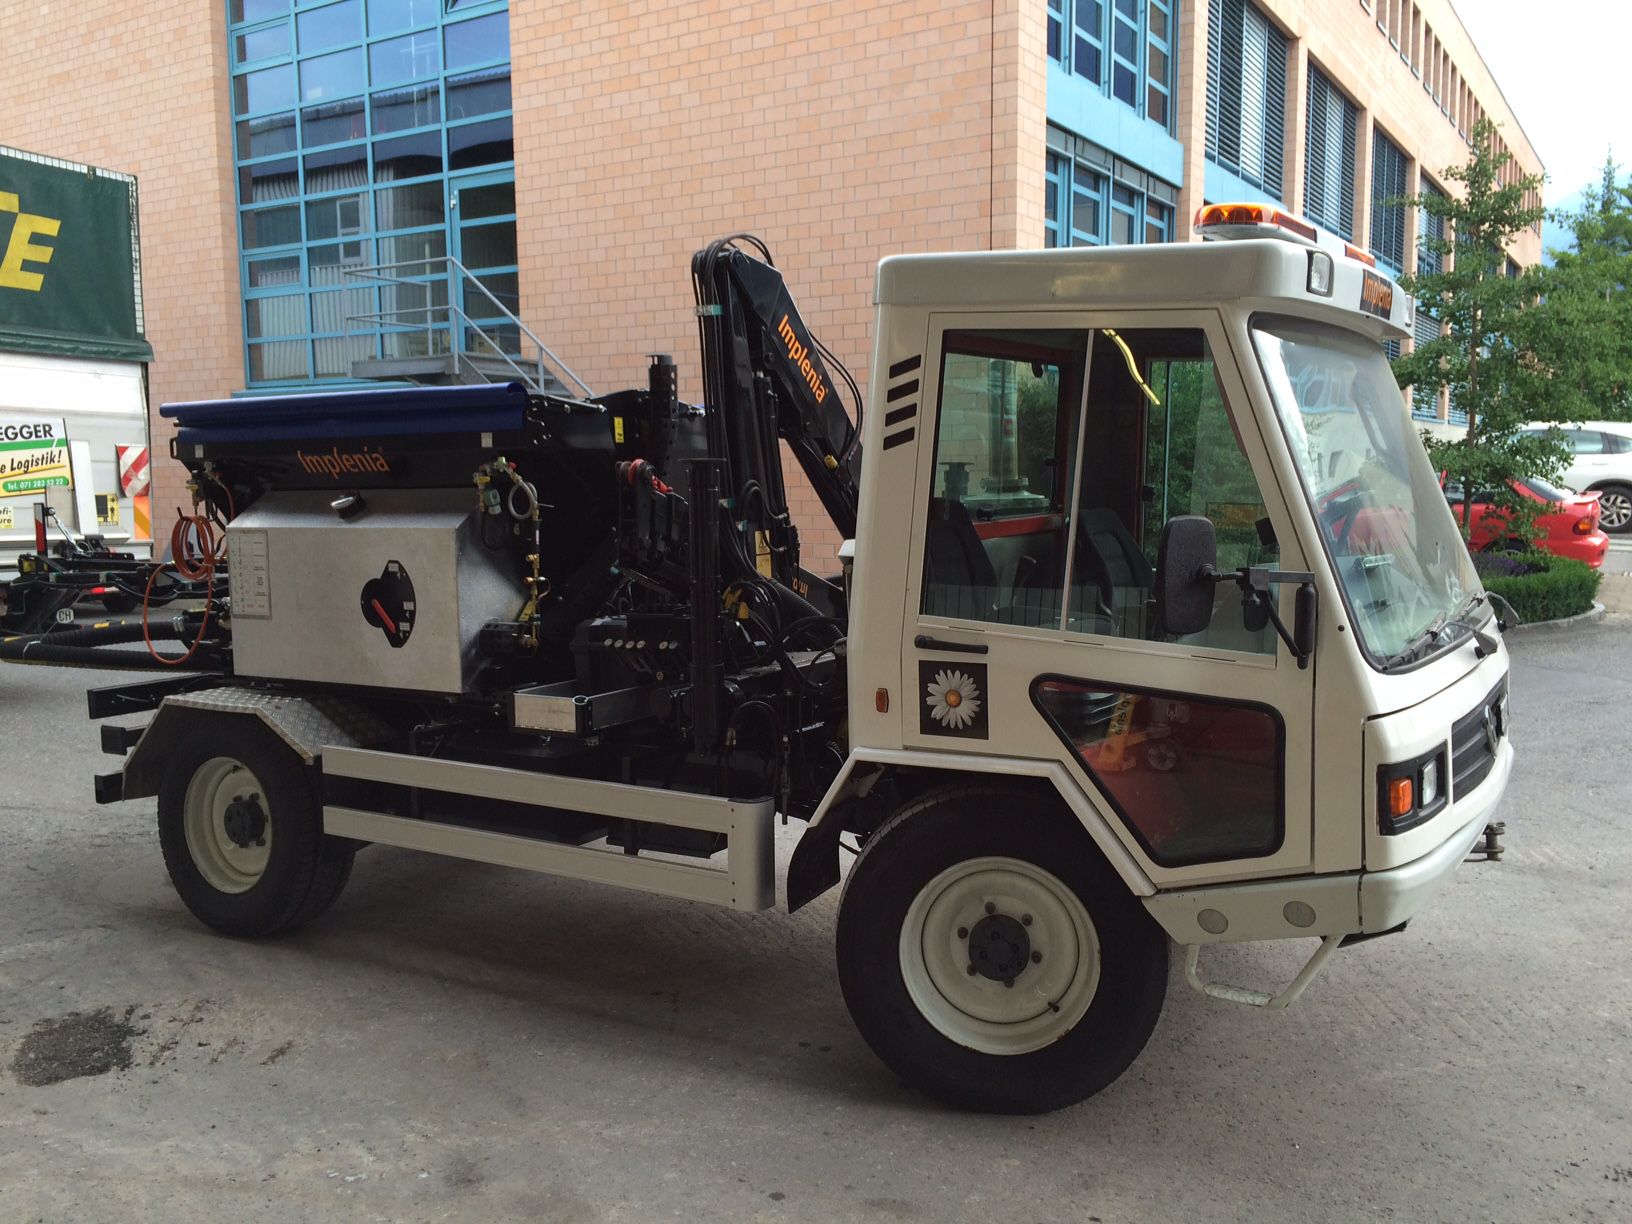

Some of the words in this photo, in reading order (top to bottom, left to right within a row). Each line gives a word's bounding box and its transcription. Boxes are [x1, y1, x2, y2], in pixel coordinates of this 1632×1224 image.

[778, 314, 826, 403] Implenia
[10, 449, 62, 474] Logistik!
[297, 446, 390, 480] Implenia
[7, 482, 18, 491] Tel.
[20, 481, 31, 489] 071
[59, 610, 71, 622] CH
